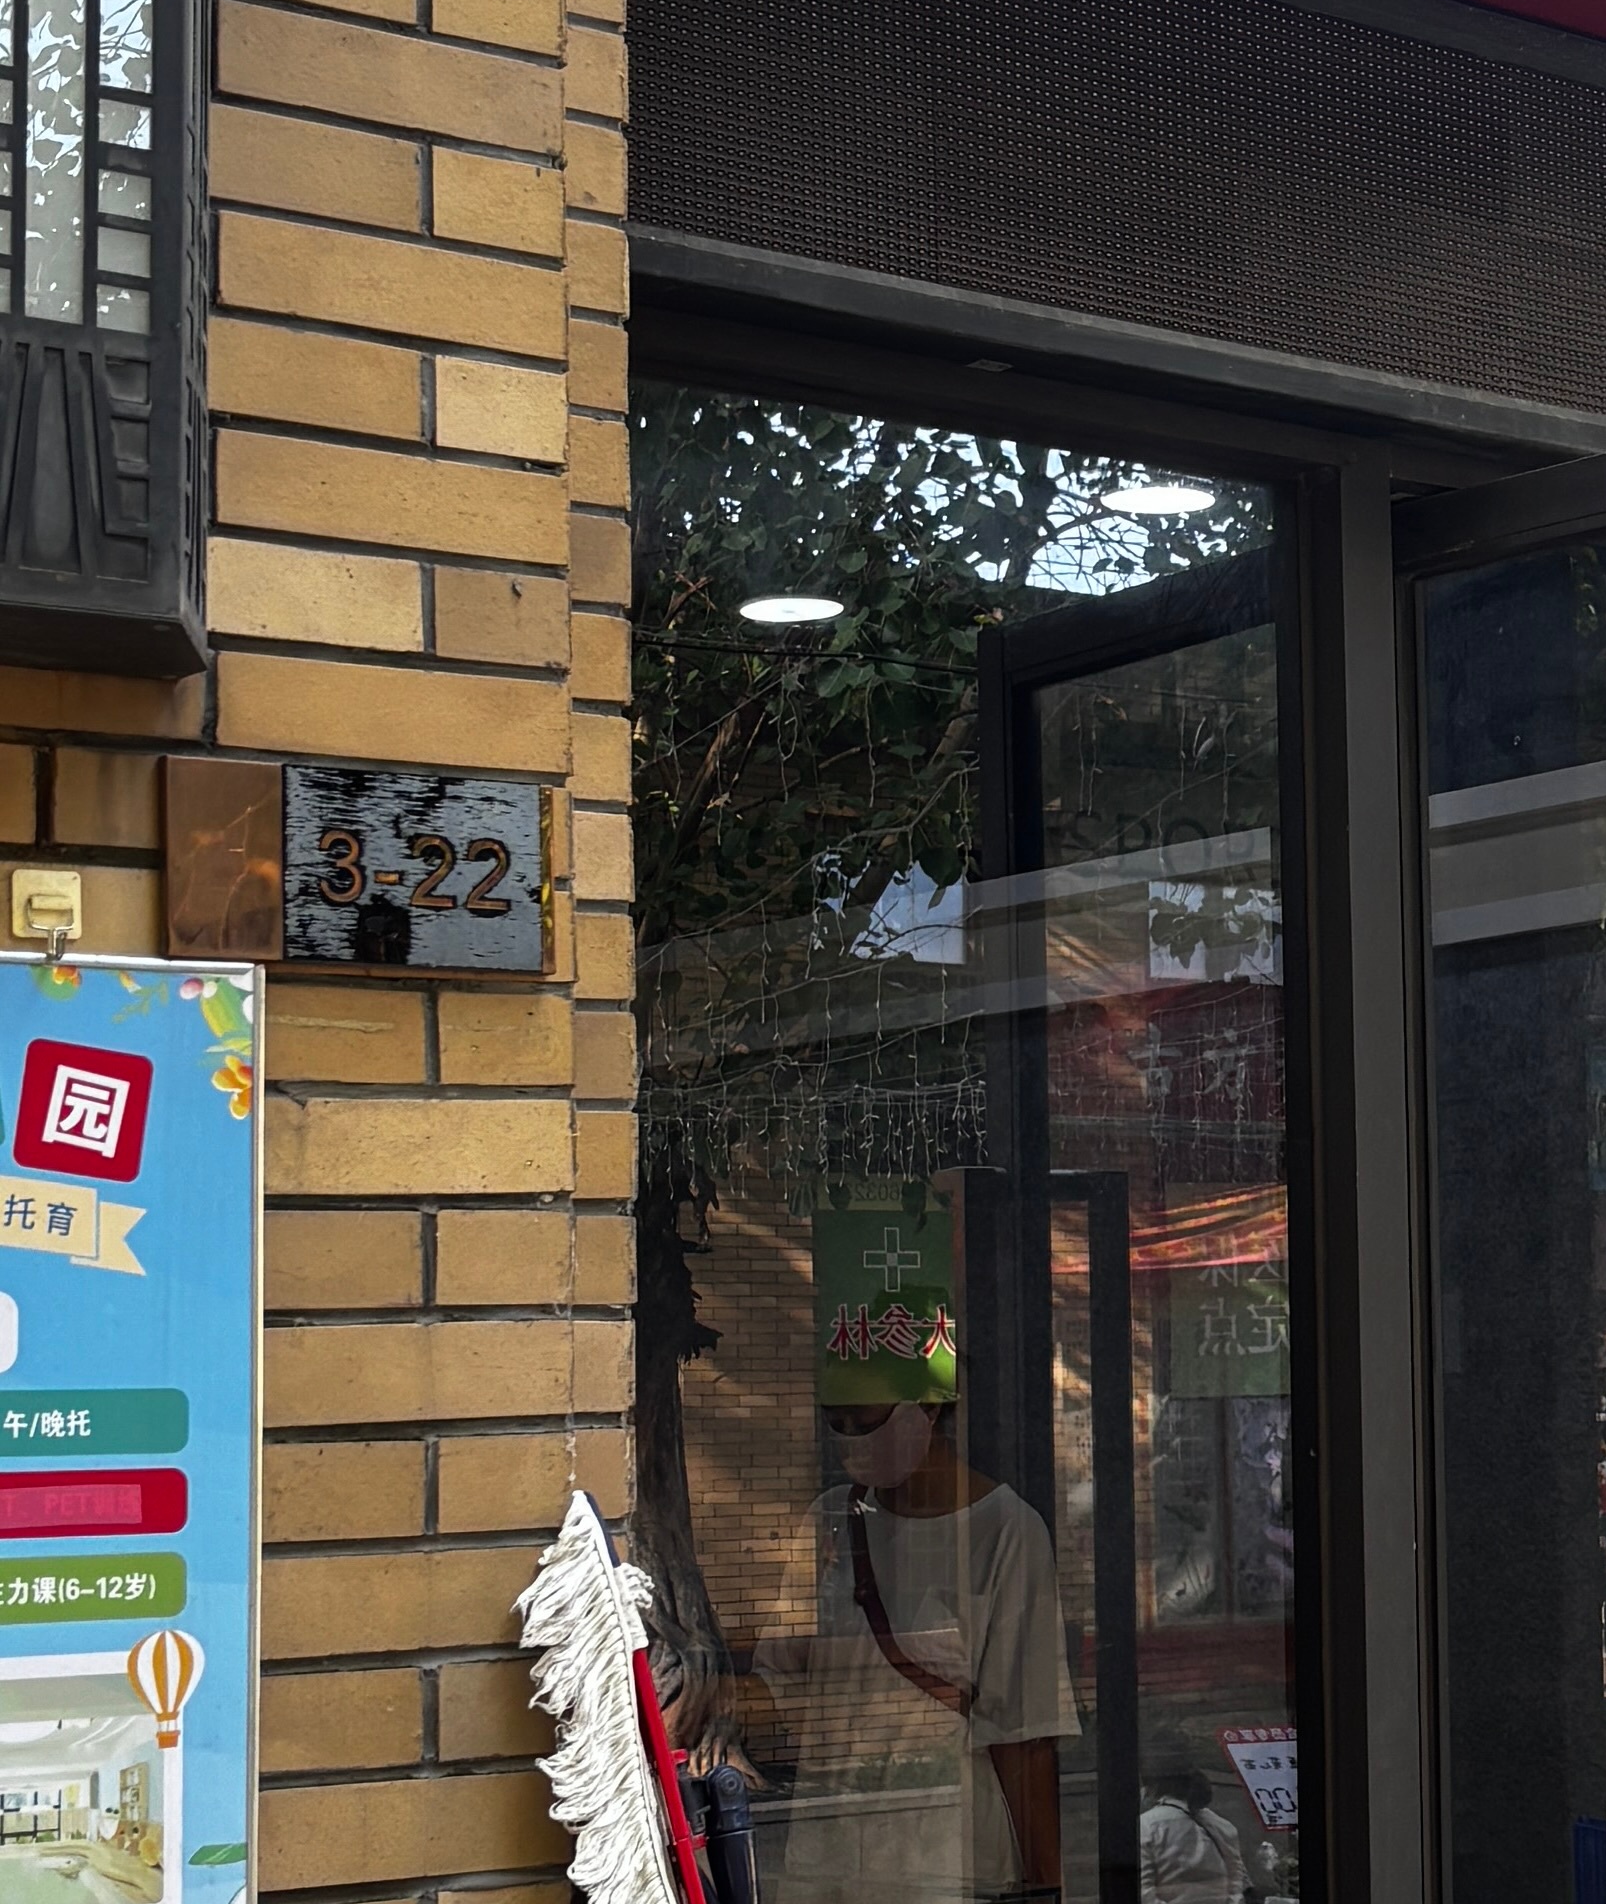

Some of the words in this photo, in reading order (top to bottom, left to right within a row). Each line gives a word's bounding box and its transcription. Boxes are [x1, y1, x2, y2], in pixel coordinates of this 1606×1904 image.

[317, 827, 512, 914] 3-22
[42, 1064, 131, 1158] 园
[3, 1194, 78, 1236] 托育
[3, 1409, 91, 1439] 午/晚托
